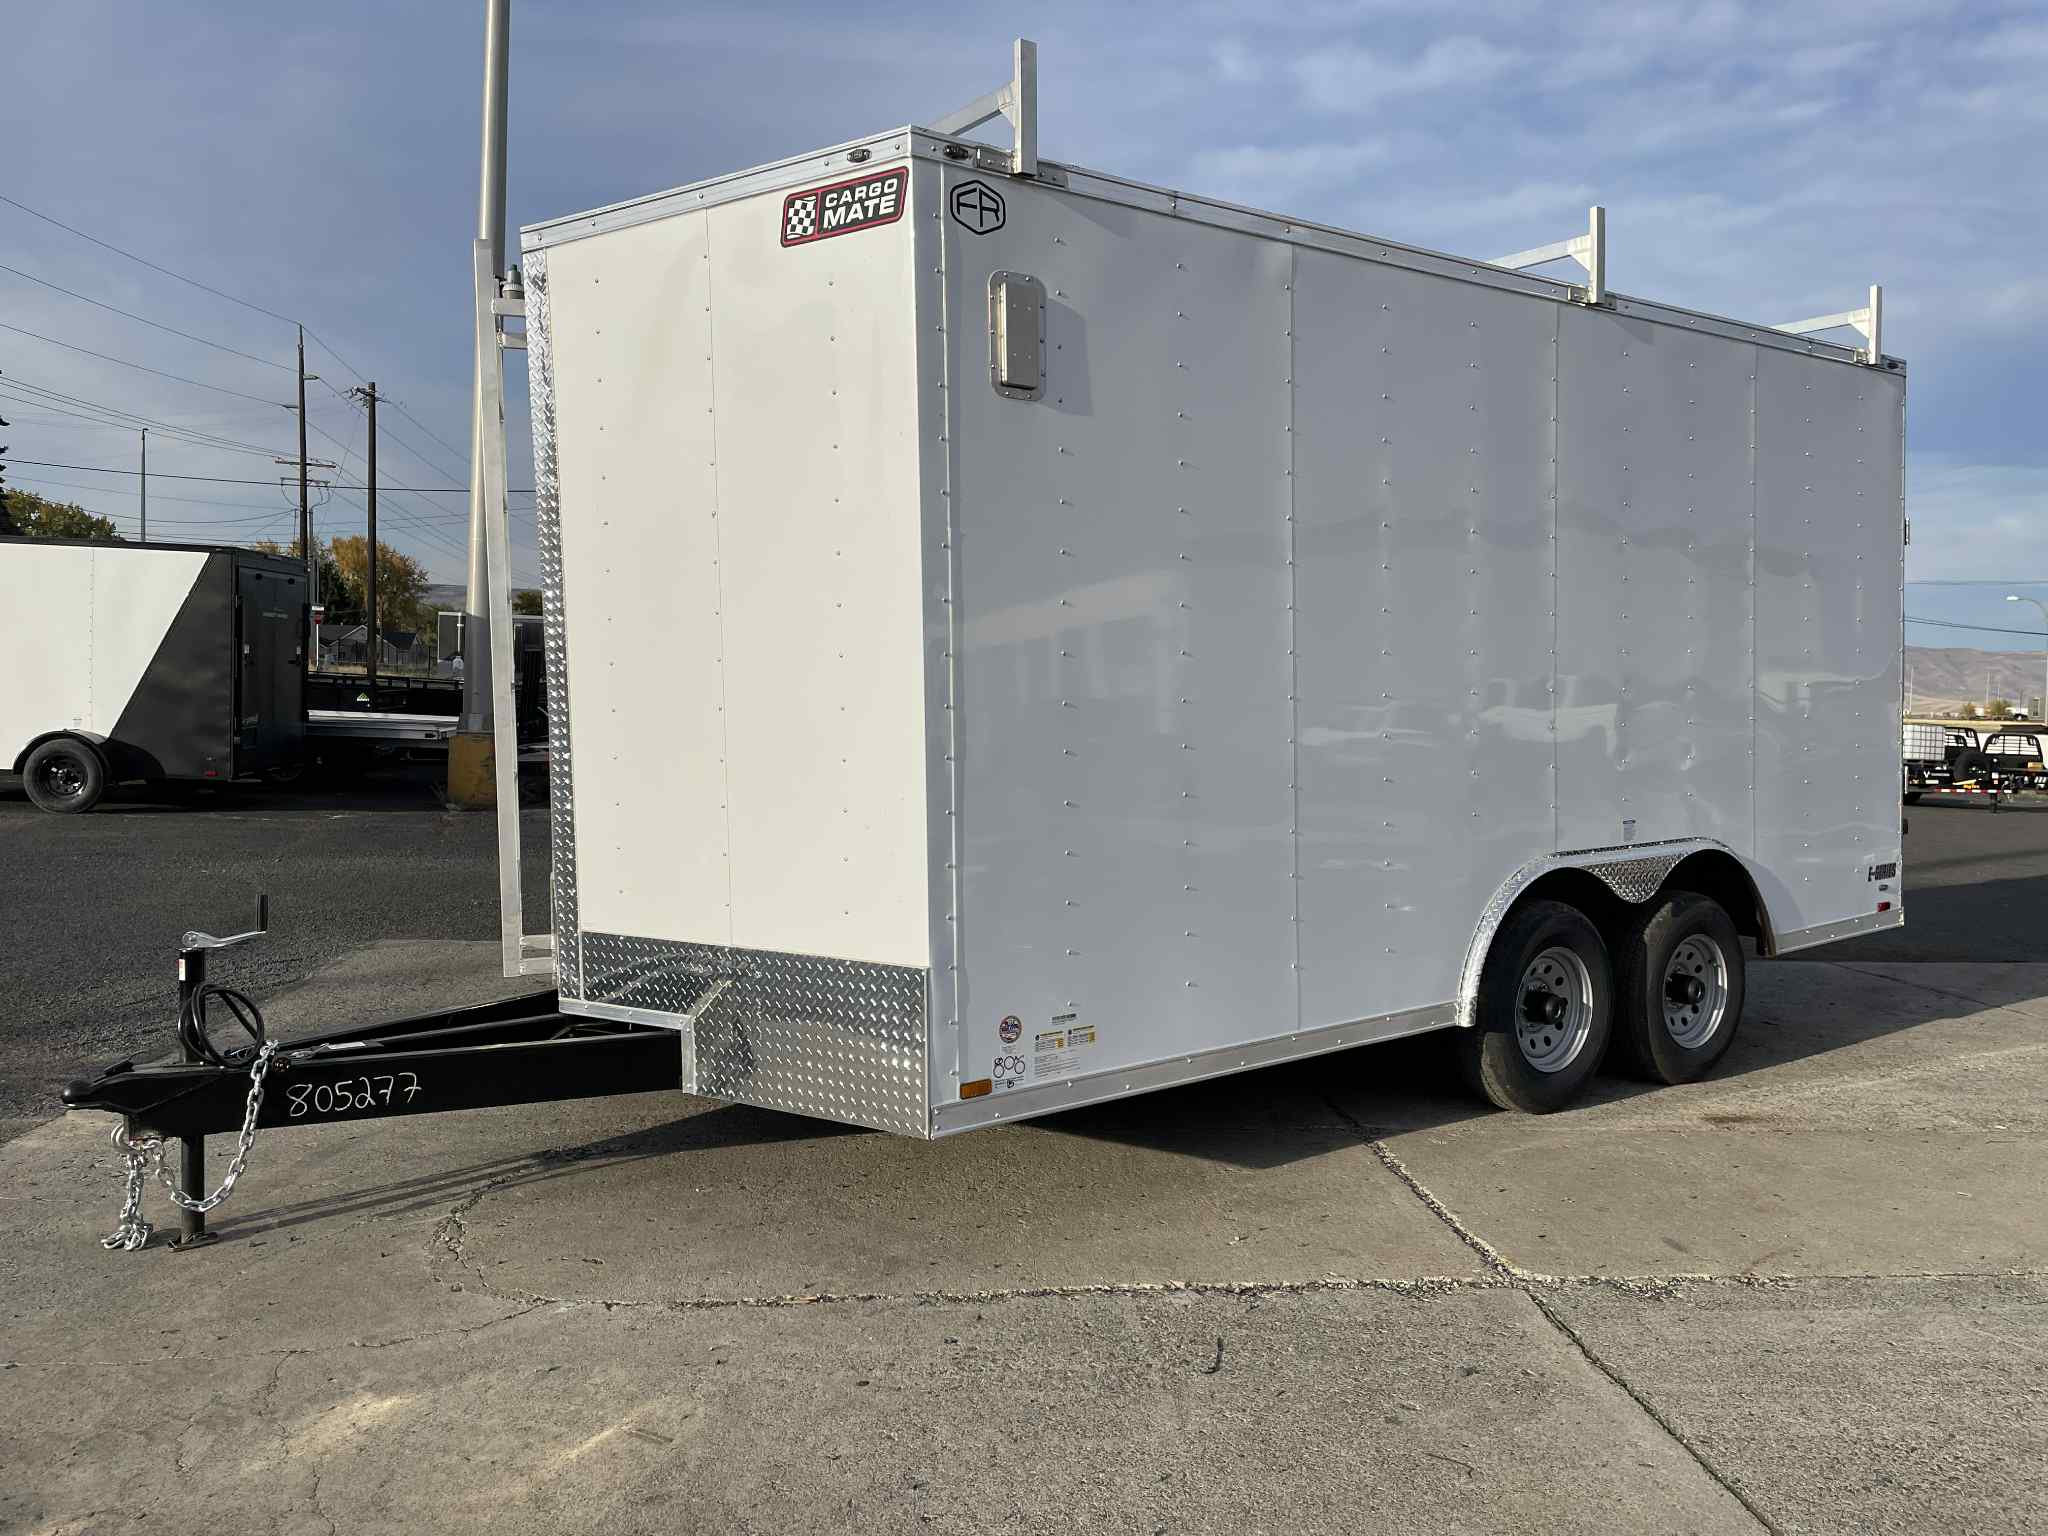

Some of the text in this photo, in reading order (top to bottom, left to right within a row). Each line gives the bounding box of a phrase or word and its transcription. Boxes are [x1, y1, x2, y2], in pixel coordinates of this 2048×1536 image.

[823, 193, 897, 229] MATE
[825, 178, 898, 208] CARGO
[286, 1072, 422, 1117] 805277
